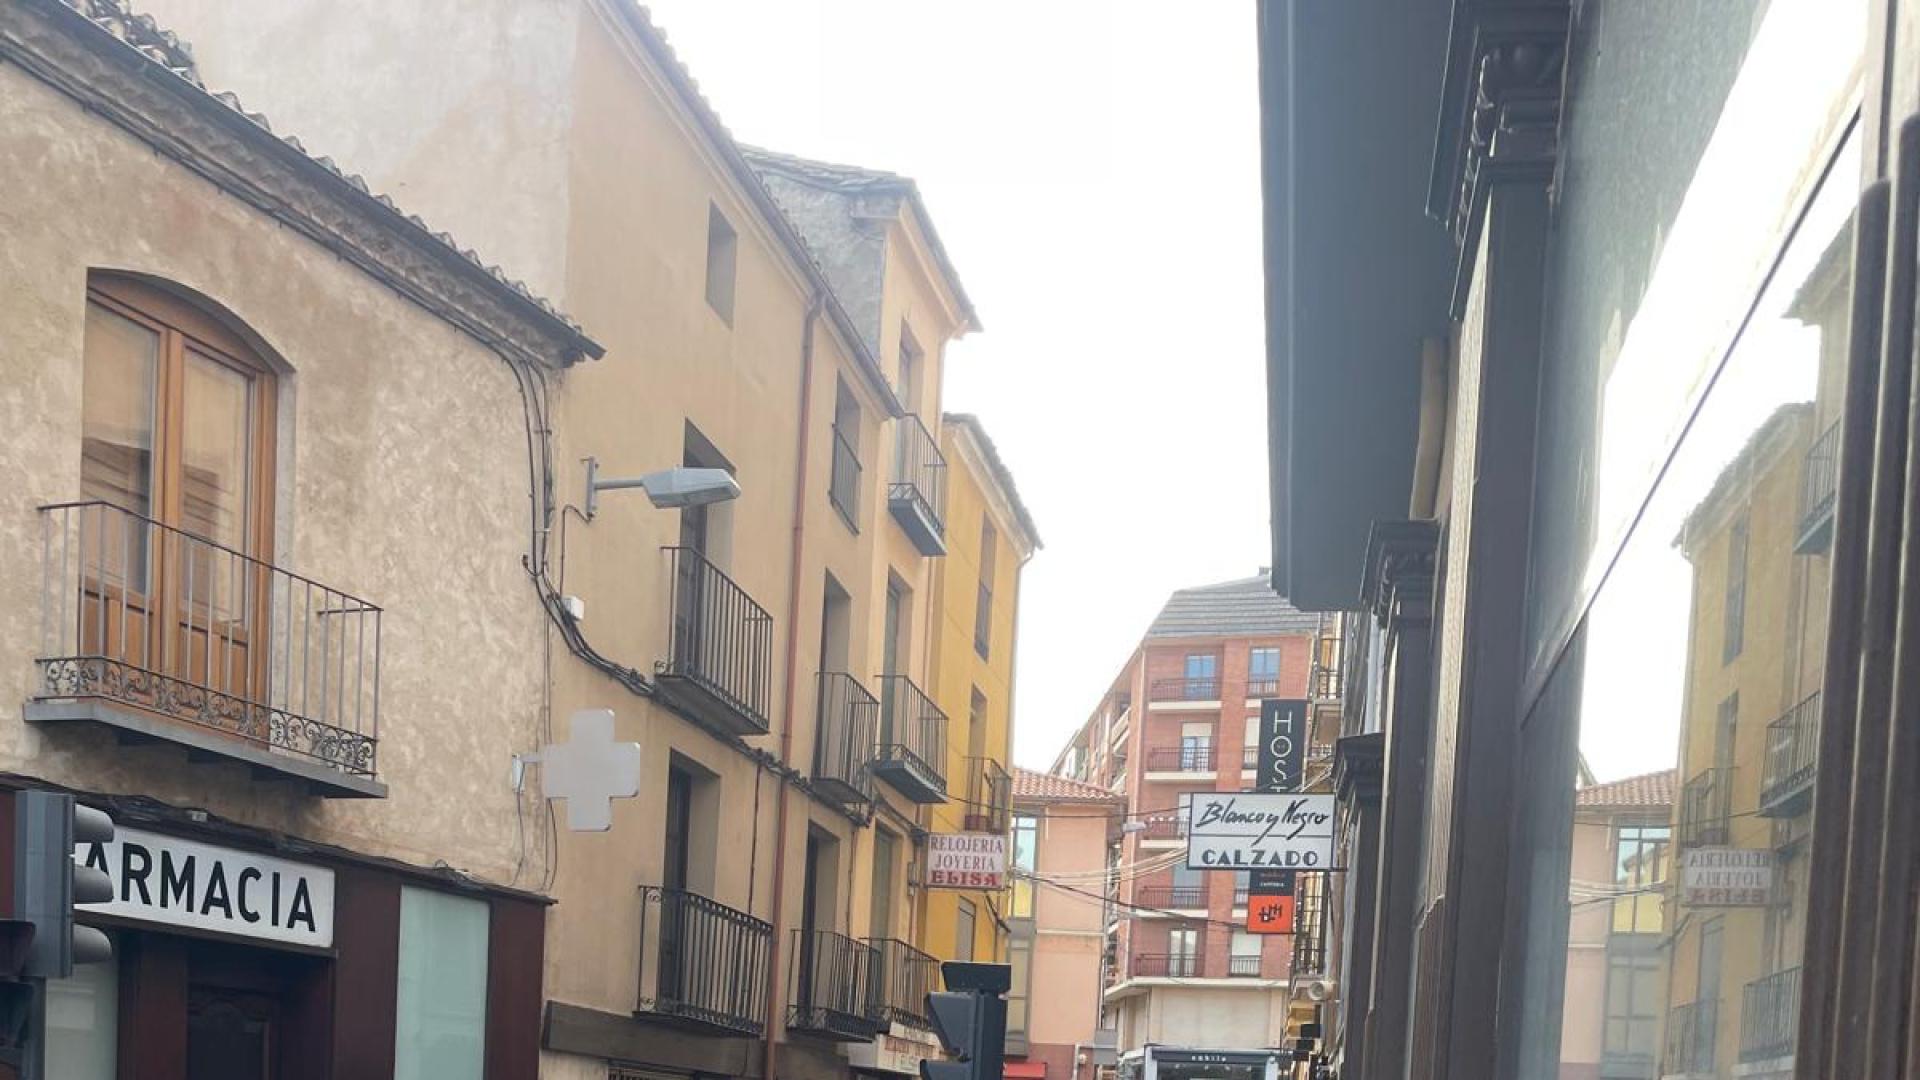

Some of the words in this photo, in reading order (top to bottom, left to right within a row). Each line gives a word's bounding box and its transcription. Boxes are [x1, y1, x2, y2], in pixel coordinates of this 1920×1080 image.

[1195, 796, 1264, 828] Blanco
[1250, 810, 1280, 847] y
[1281, 798, 1330, 841] Negro
[930, 836, 1003, 853] RELOJERIA
[935, 854, 996, 871] JOYERIA
[1201, 849, 1319, 867] CALZADO
[930, 870, 998, 886] ELISA
[85, 841, 317, 933] ARMACIA
